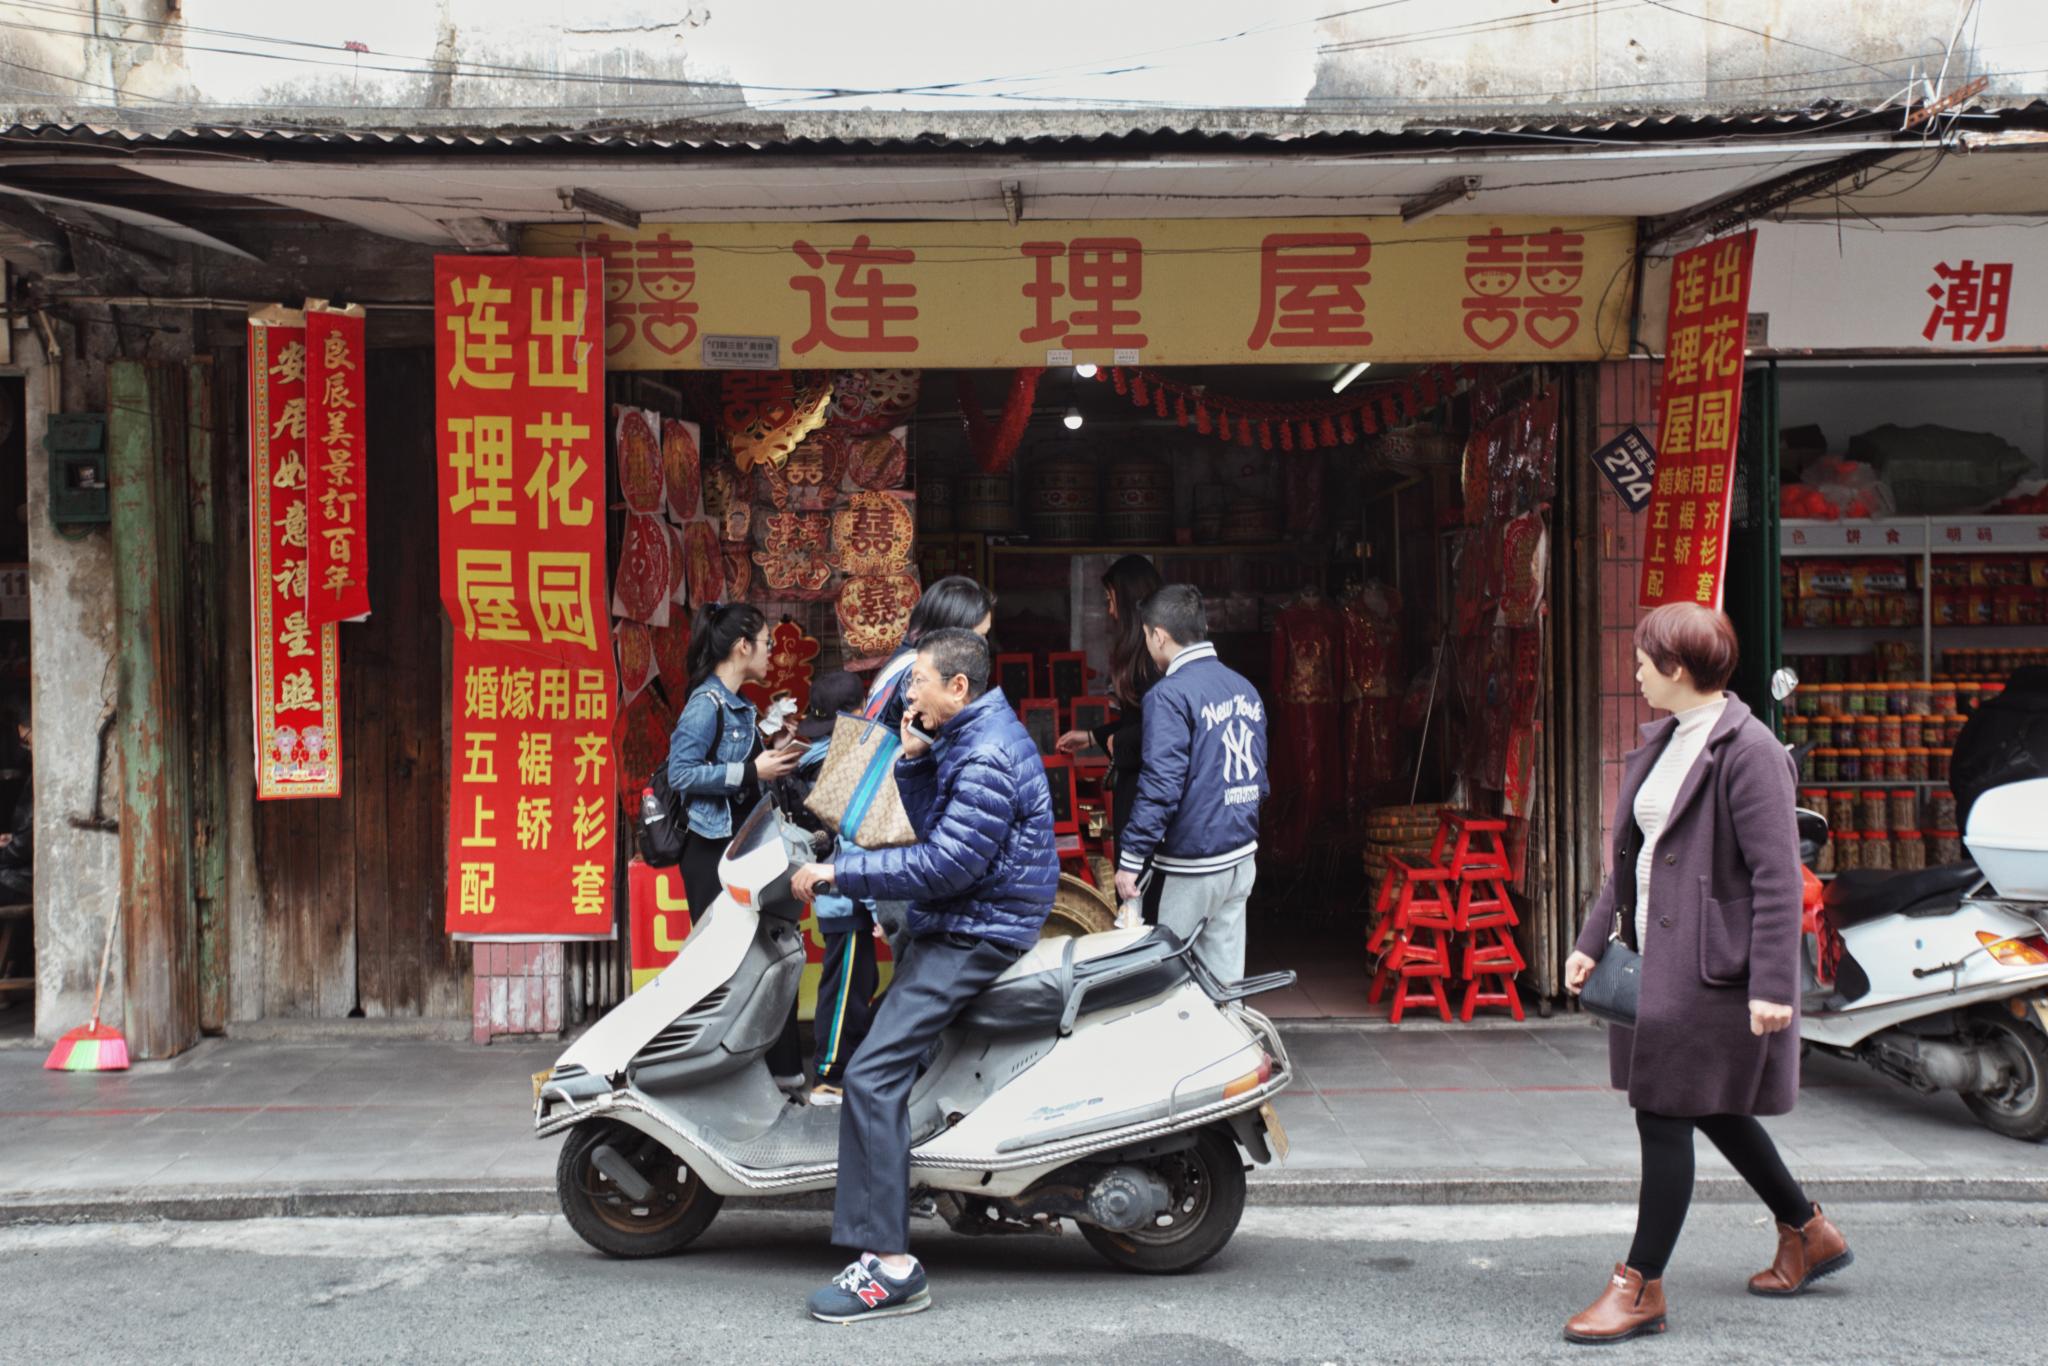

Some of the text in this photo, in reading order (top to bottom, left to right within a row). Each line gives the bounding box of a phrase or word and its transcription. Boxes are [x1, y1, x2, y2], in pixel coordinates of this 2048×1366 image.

[789, 232, 1374, 354] 连理屋
[1660, 254, 1707, 454] 连理屋
[1695, 243, 1742, 452] 出花园
[1922, 259, 2014, 342] 潮
[447, 274, 531, 642] 连理屋
[524, 275, 598, 651] 出花园
[1604, 446, 1653, 502] 274
[1657, 464, 1724, 495] 婚嫁用品
[464, 665, 608, 721] 婚嫁用品
